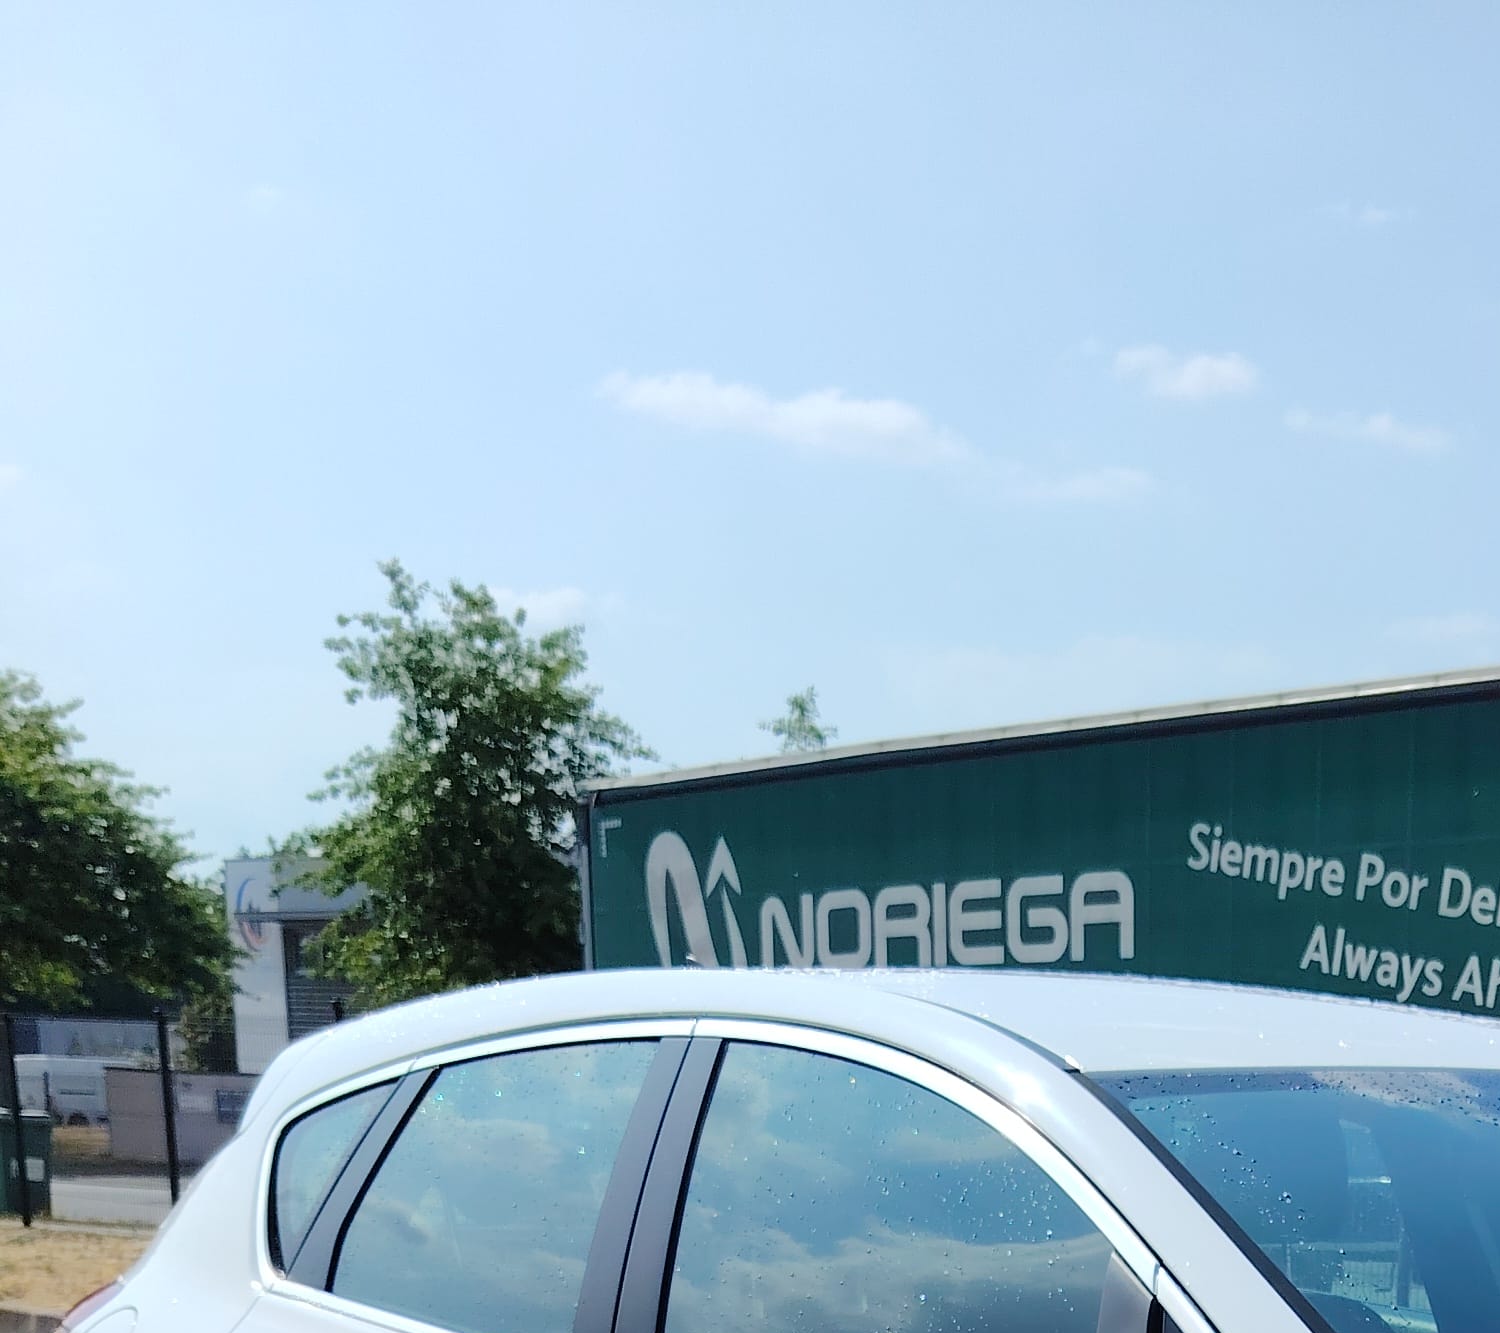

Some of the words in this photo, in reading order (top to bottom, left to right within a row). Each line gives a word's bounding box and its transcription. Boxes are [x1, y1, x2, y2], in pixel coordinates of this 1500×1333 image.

[1186, 822, 1345, 900] Siempre
[1356, 852, 1429, 911] Por
[760, 870, 1136, 968] NORIEGA
[1299, 923, 1445, 1003] Always
